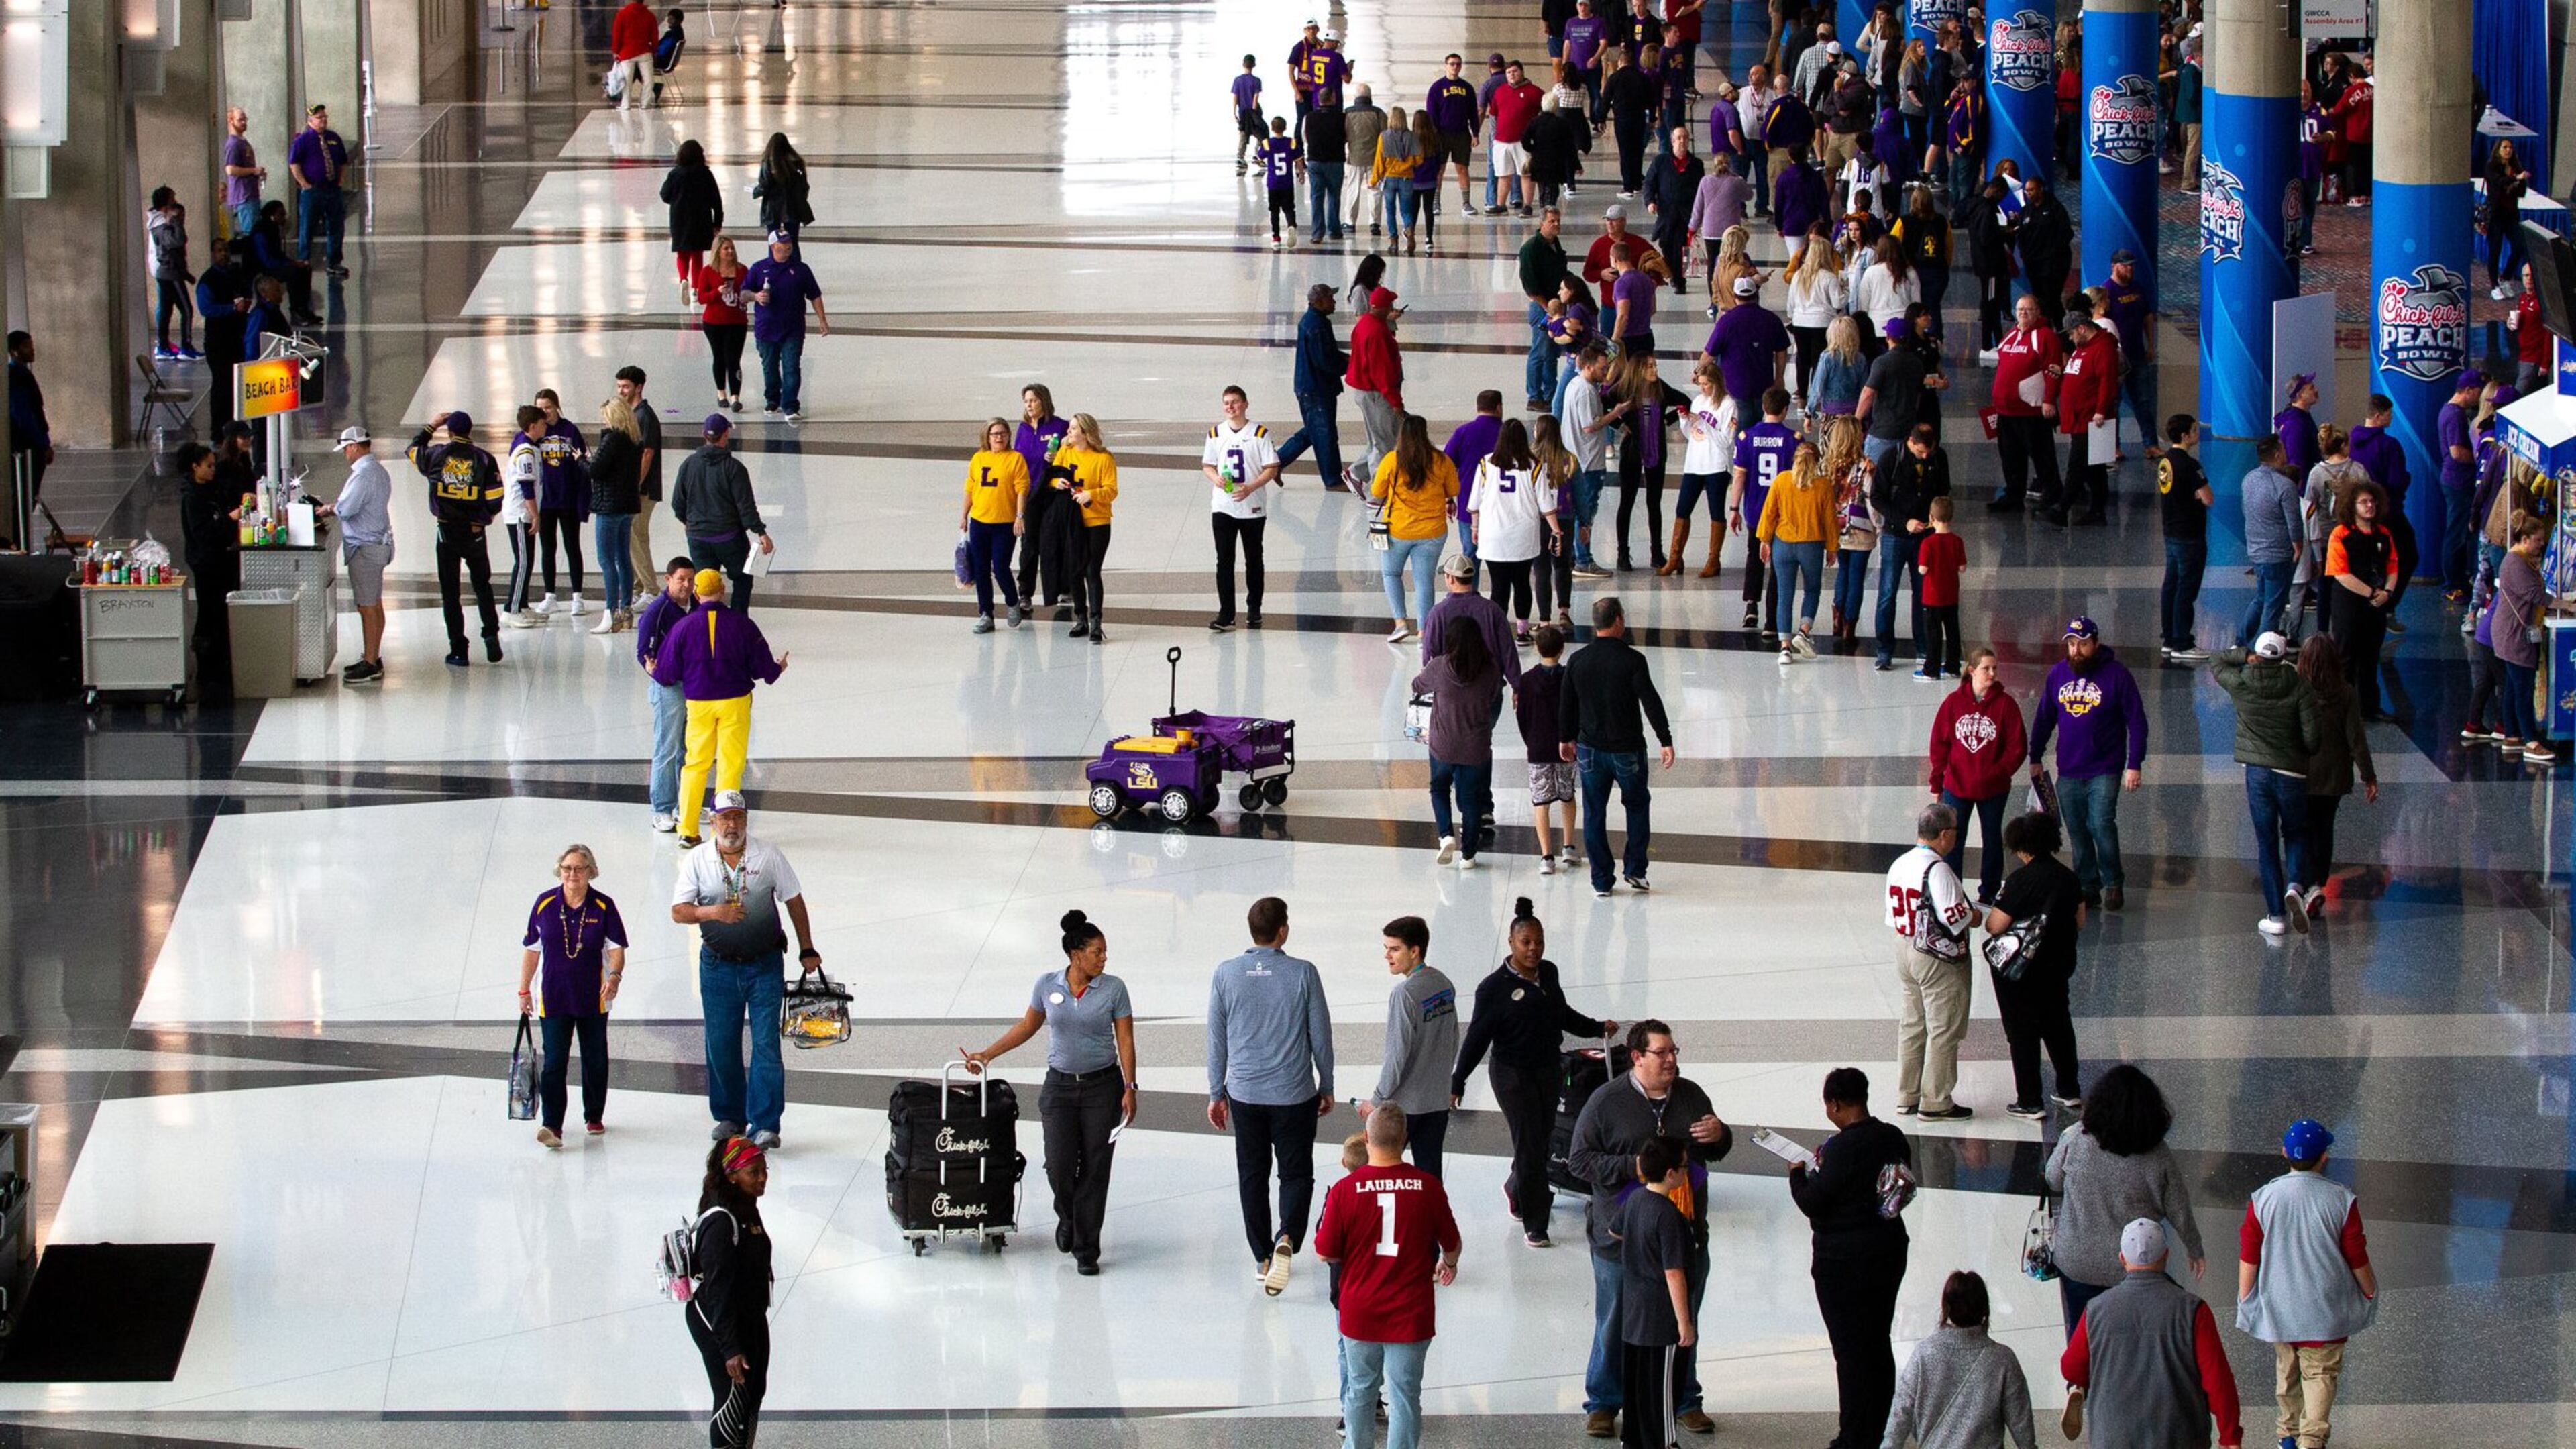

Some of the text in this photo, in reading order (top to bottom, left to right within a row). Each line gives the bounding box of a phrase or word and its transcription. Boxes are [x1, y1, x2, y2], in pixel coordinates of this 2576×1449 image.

[1912, 0, 1965, 14] PEACH
[2304, 17, 2337, 25] Assembly
[1993, 52, 2051, 70] PEACH
[1314, 62, 1325, 84] 9
[2002, 69, 2041, 77] BOWL
[1443, 85, 1466, 97] LSU
[2093, 98, 2157, 125] Chick-fil-A
[2092, 122, 2156, 142] PEACH
[2104, 140, 2147, 148] BOWL
[1273, 152, 1287, 176] 5
[1857, 168, 1872, 184] 18
[2382, 293, 2465, 329] Chick-fil-A
[2383, 325, 2464, 351] PEACH
[2397, 350, 2452, 360] BOWL
[246, 378, 276, 400] BEACH
[1753, 436, 1784, 448] BURROW
[2508, 424, 2518, 449] ICE
[2519, 432, 2540, 464] CREAM
[981, 466, 998, 487] L
[1069, 463, 1085, 487] L
[1227, 449, 1246, 484] 3
[1758, 452, 1778, 487] 9
[1499, 467, 1517, 493] 5
[437, 481, 479, 501] LSU
[99, 599, 154, 613] BRAXTON
[2065, 704, 2090, 714] LSU
[1262, 744, 1281, 752] Academy
[1128, 777, 1158, 789] LSU
[1945, 902, 1967, 926] 28
[935, 1127, 990, 1154] Chick-fil-A
[1355, 1179, 1423, 1193] LAUBACH
[932, 1193, 988, 1219] Chick-fil-A
[1375, 1193, 1399, 1257] 1
